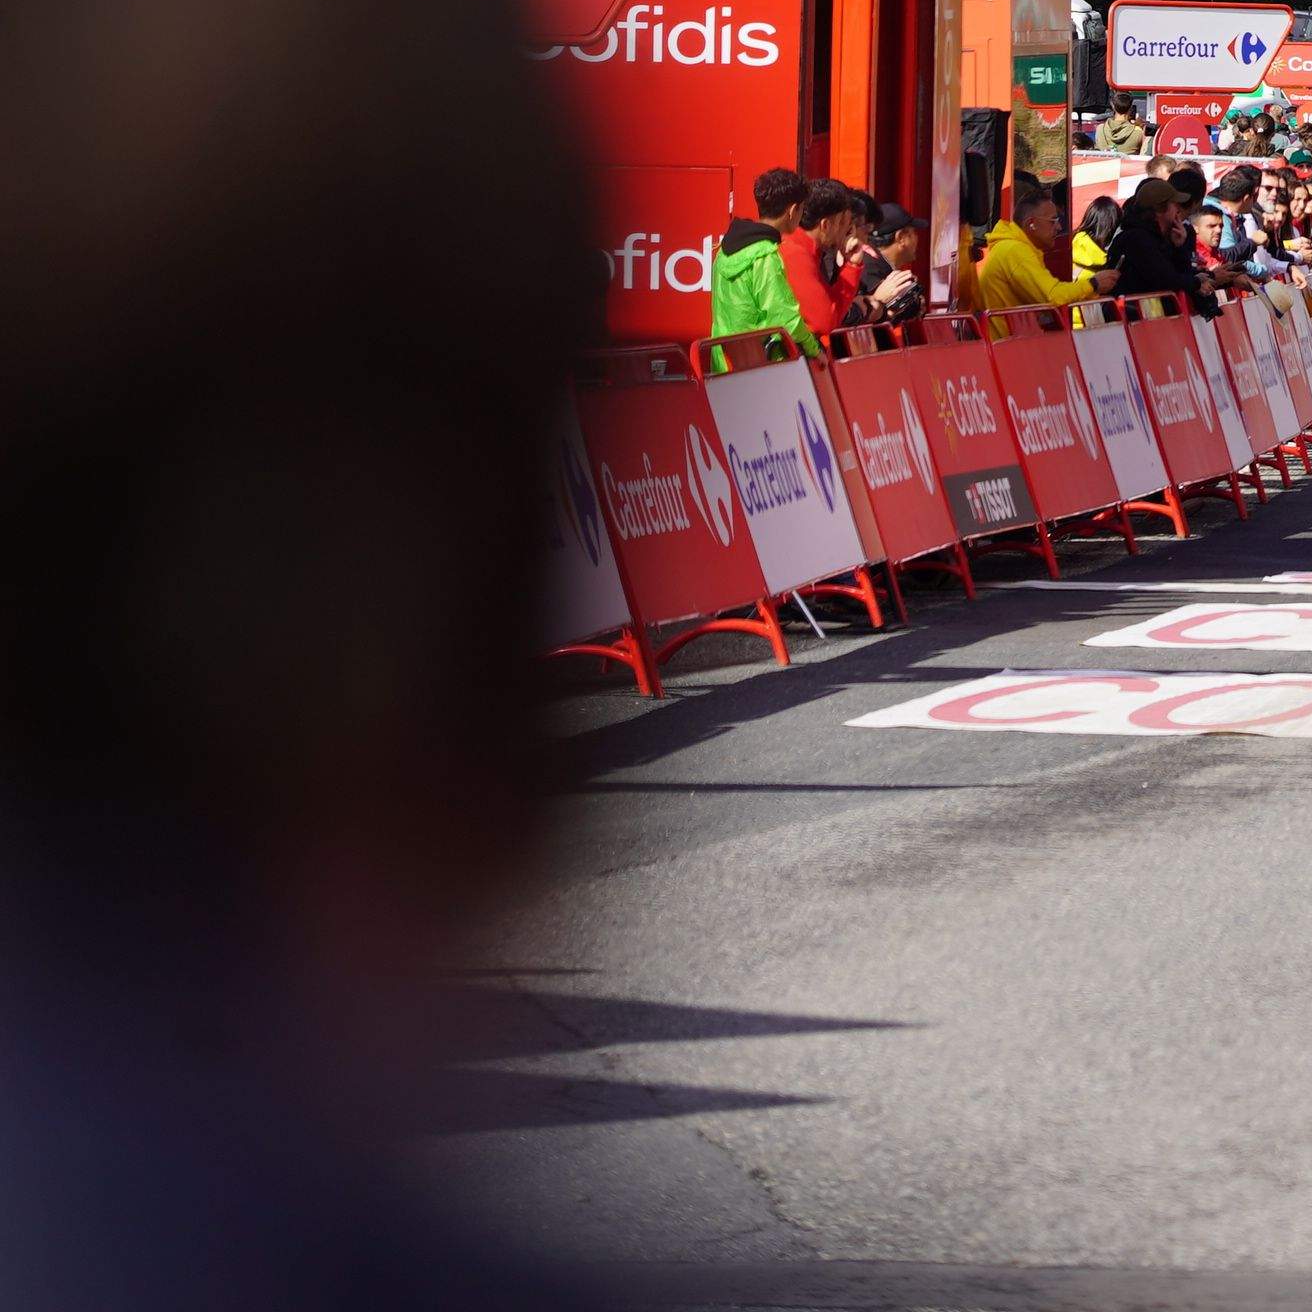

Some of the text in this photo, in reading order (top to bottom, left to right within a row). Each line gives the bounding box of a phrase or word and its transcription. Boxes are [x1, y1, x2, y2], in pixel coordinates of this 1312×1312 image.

[1122, 35, 1218, 58] Carrefour
[1160, 104, 1202, 115] Carrefour
[1172, 137, 1199, 156] 25
[853, 411, 913, 491] Carrefour
[1006, 385, 1075, 457] Carrefour
[601, 451, 691, 541] Carrefour
[728, 429, 807, 517] Carrefour
